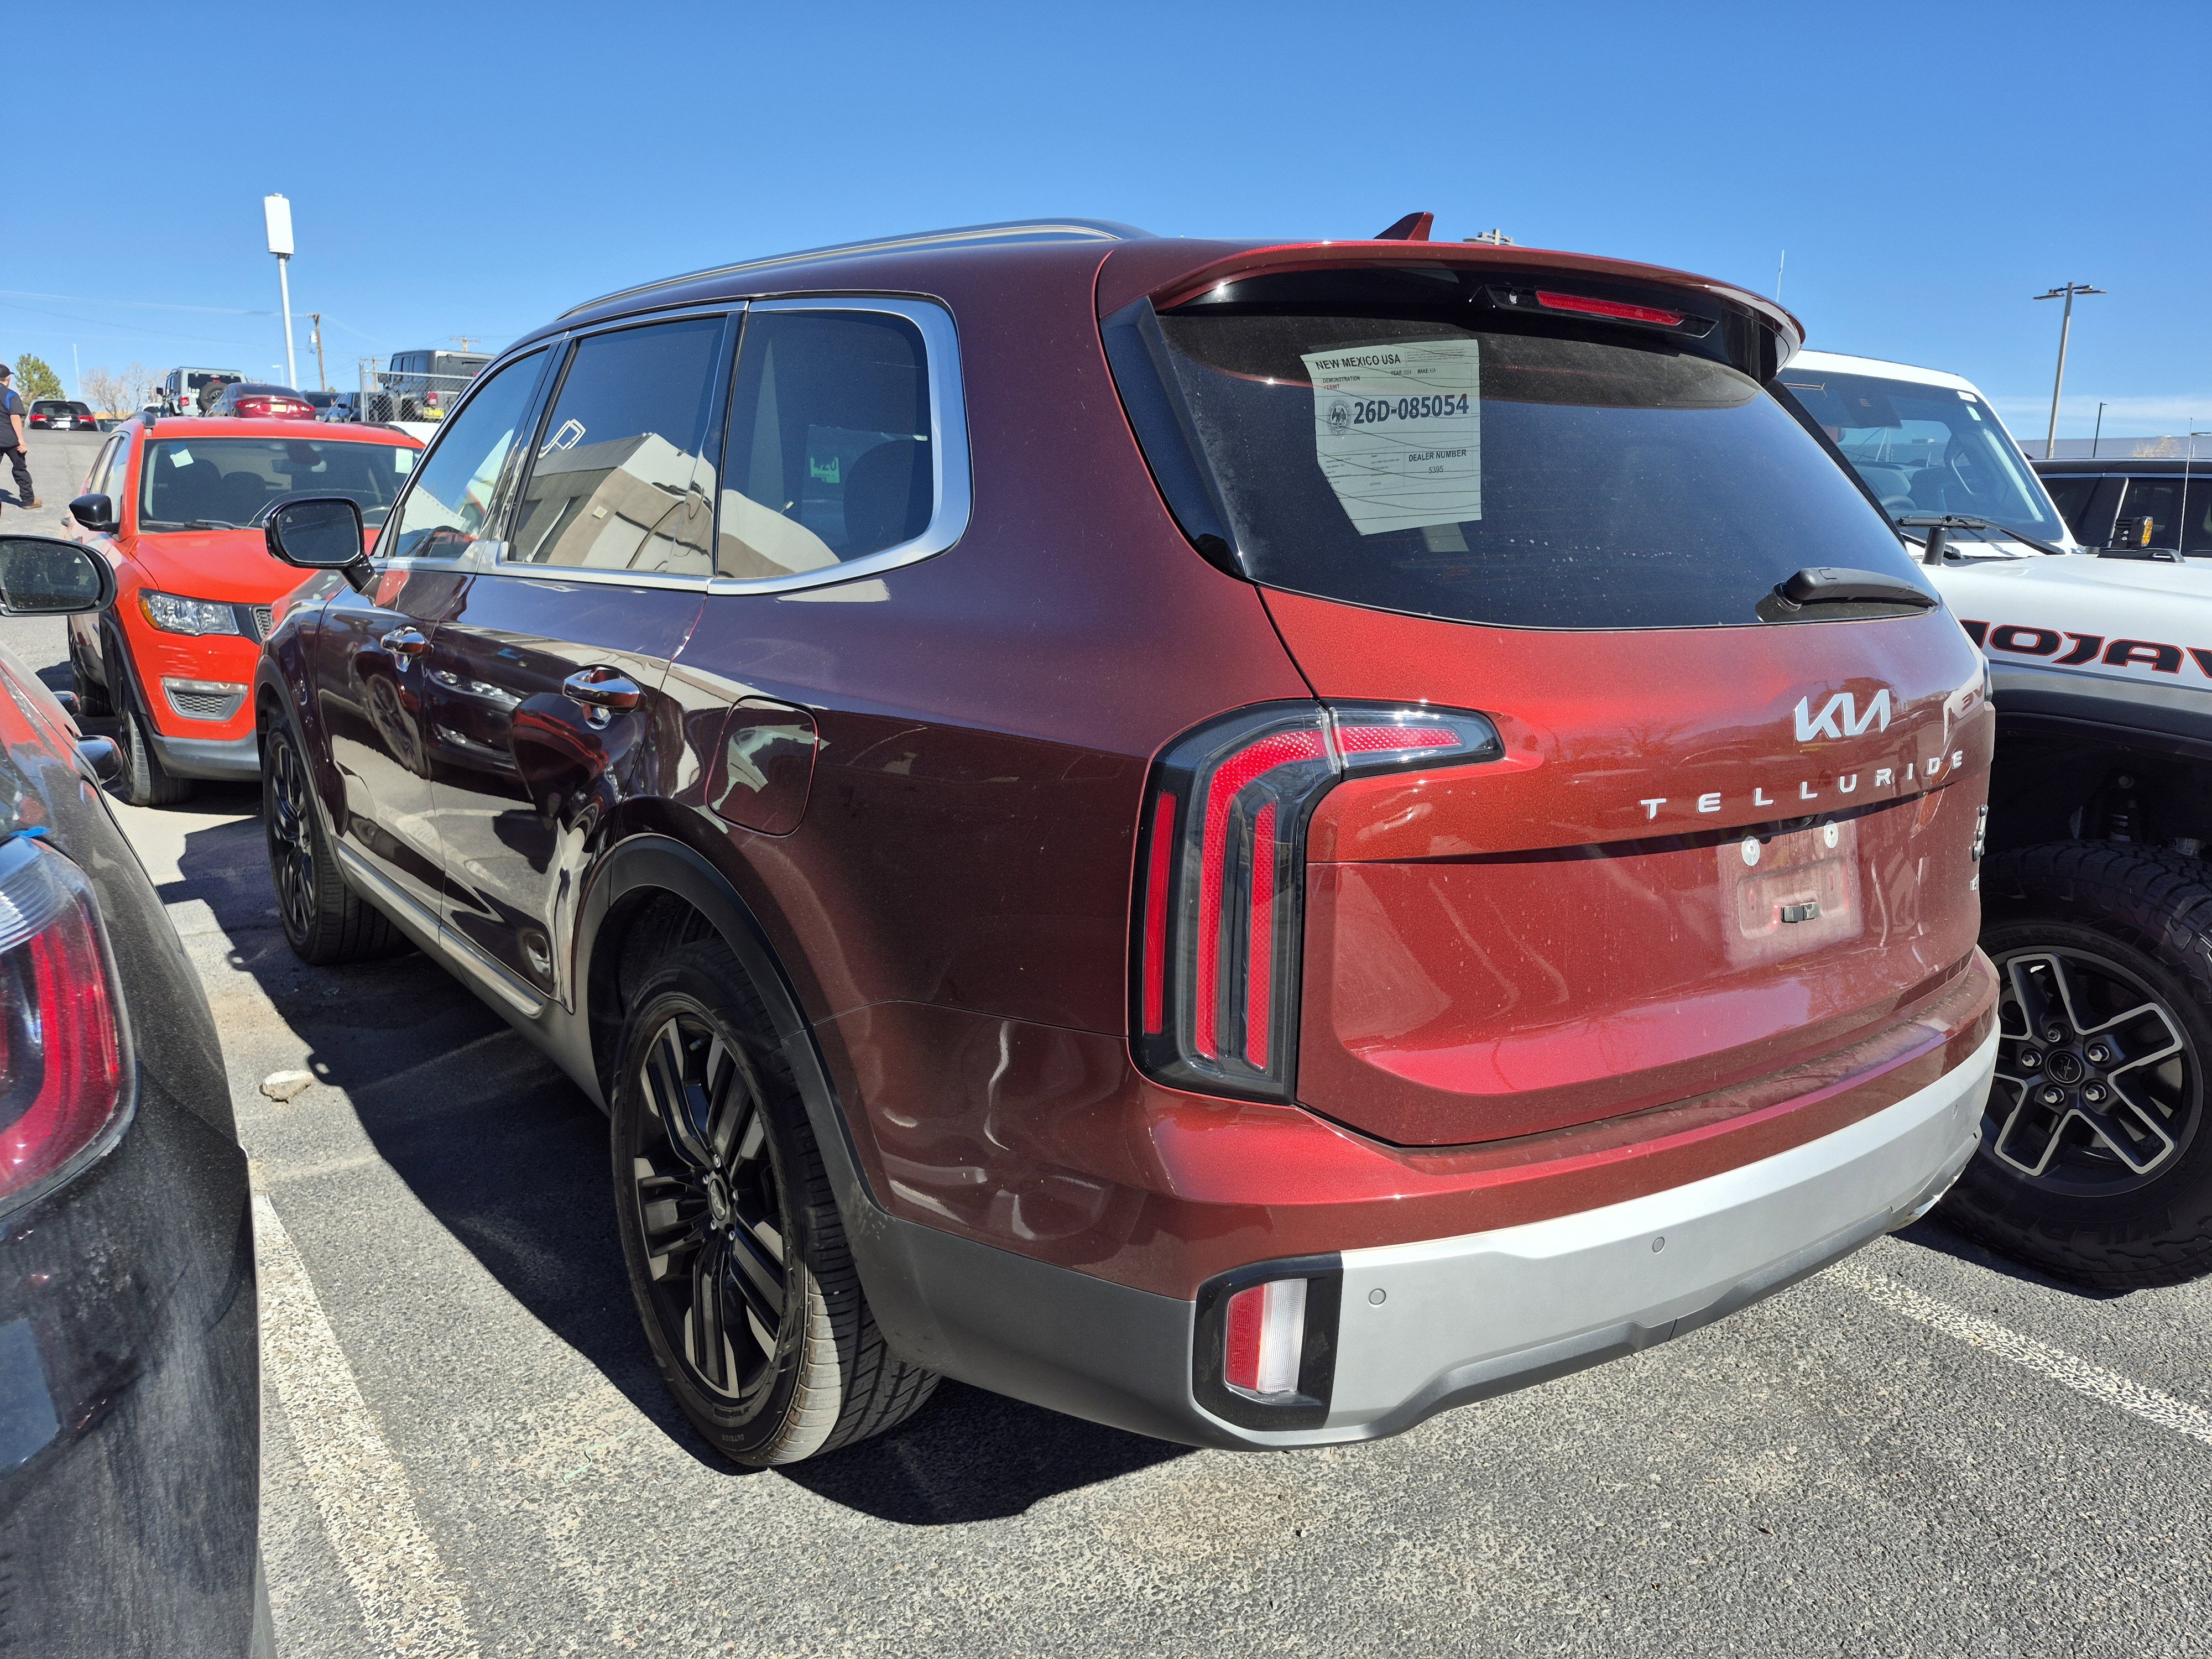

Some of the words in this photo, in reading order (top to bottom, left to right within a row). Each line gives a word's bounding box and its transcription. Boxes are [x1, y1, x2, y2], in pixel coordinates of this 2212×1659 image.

[1316, 359, 1339, 370] NEW
[1342, 356, 1380, 368] MEXICO
[1381, 354, 1401, 365] USA
[1354, 393, 1469, 424] 26D-085054
[1408, 452, 1434, 462] DEALER
[1436, 449, 1467, 459] NUMBER
[1428, 465, 1444, 474] 5395
[1794, 689, 1891, 742] KIA
[1640, 750, 1963, 819] TELLURIDE
[722, 1433, 745, 1443] OUTSIDE
